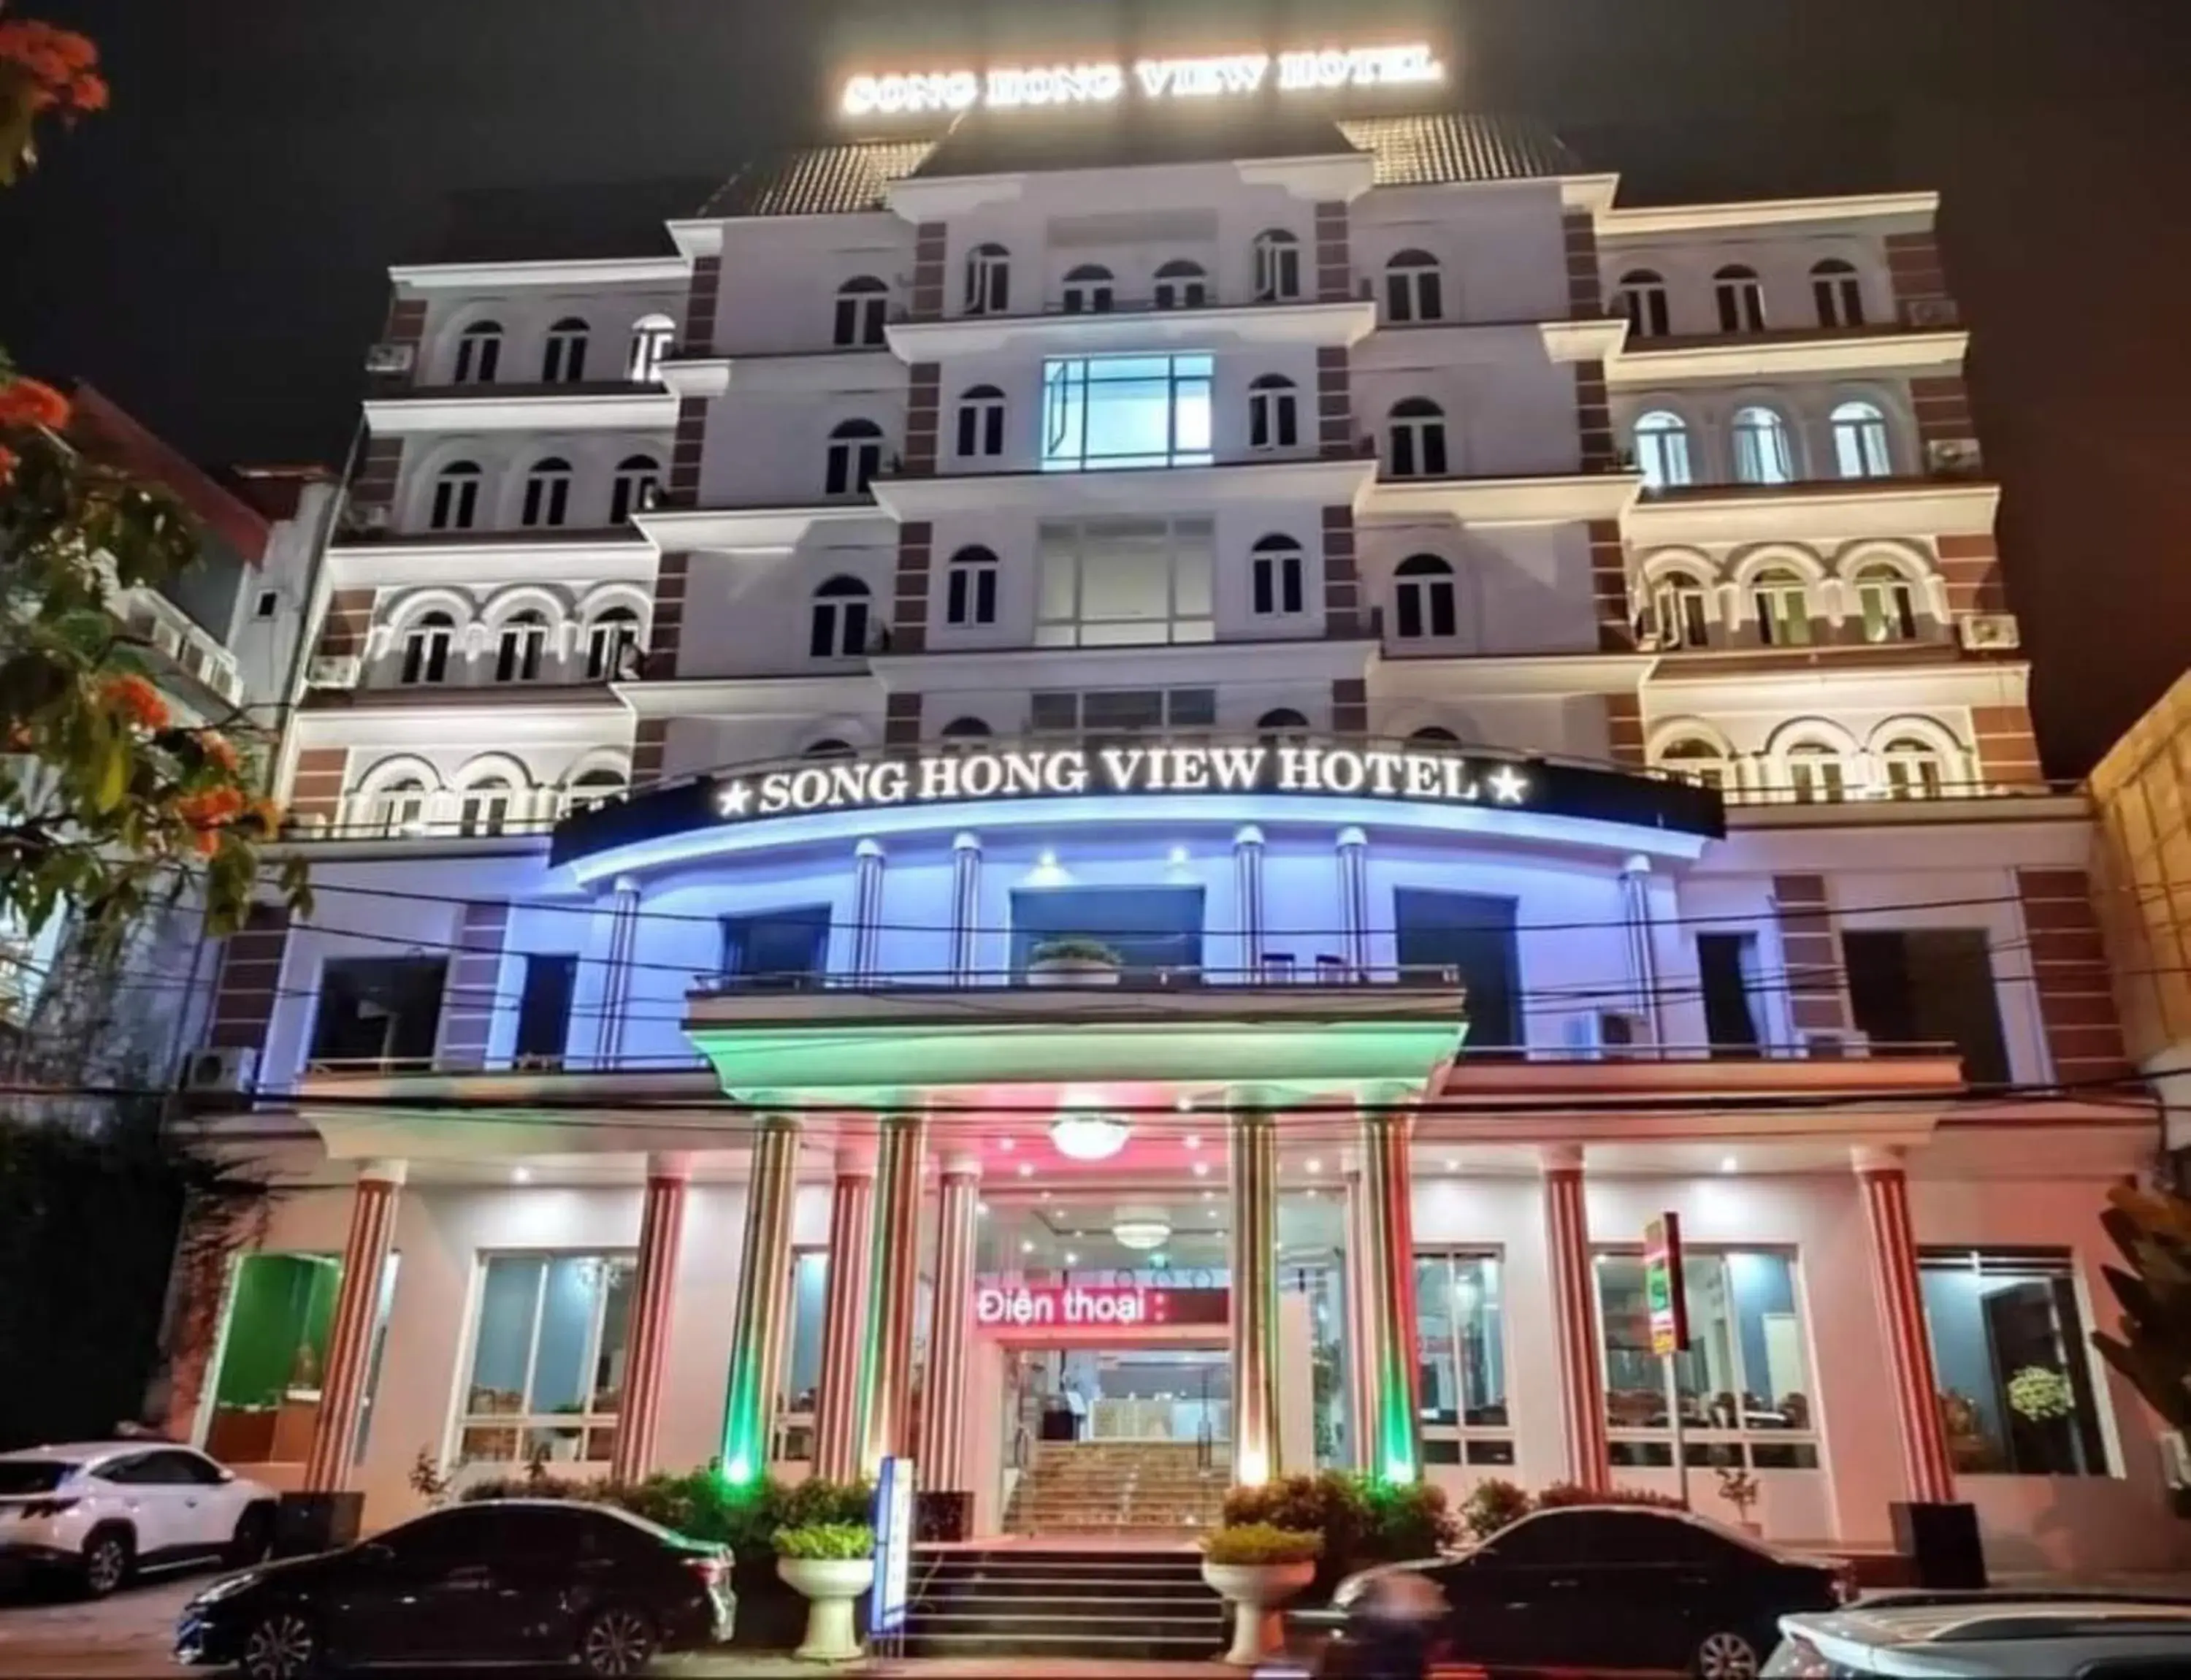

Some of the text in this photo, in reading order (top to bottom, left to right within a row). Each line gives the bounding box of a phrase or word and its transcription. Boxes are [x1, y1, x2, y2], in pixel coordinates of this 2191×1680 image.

[1134, 54, 1269, 96] VIEW
[759, 747, 1479, 812] SONG HONG VIEW HOTEL
[977, 1286, 1053, 1325] Điện
[1063, 1286, 1145, 1325] thoại
